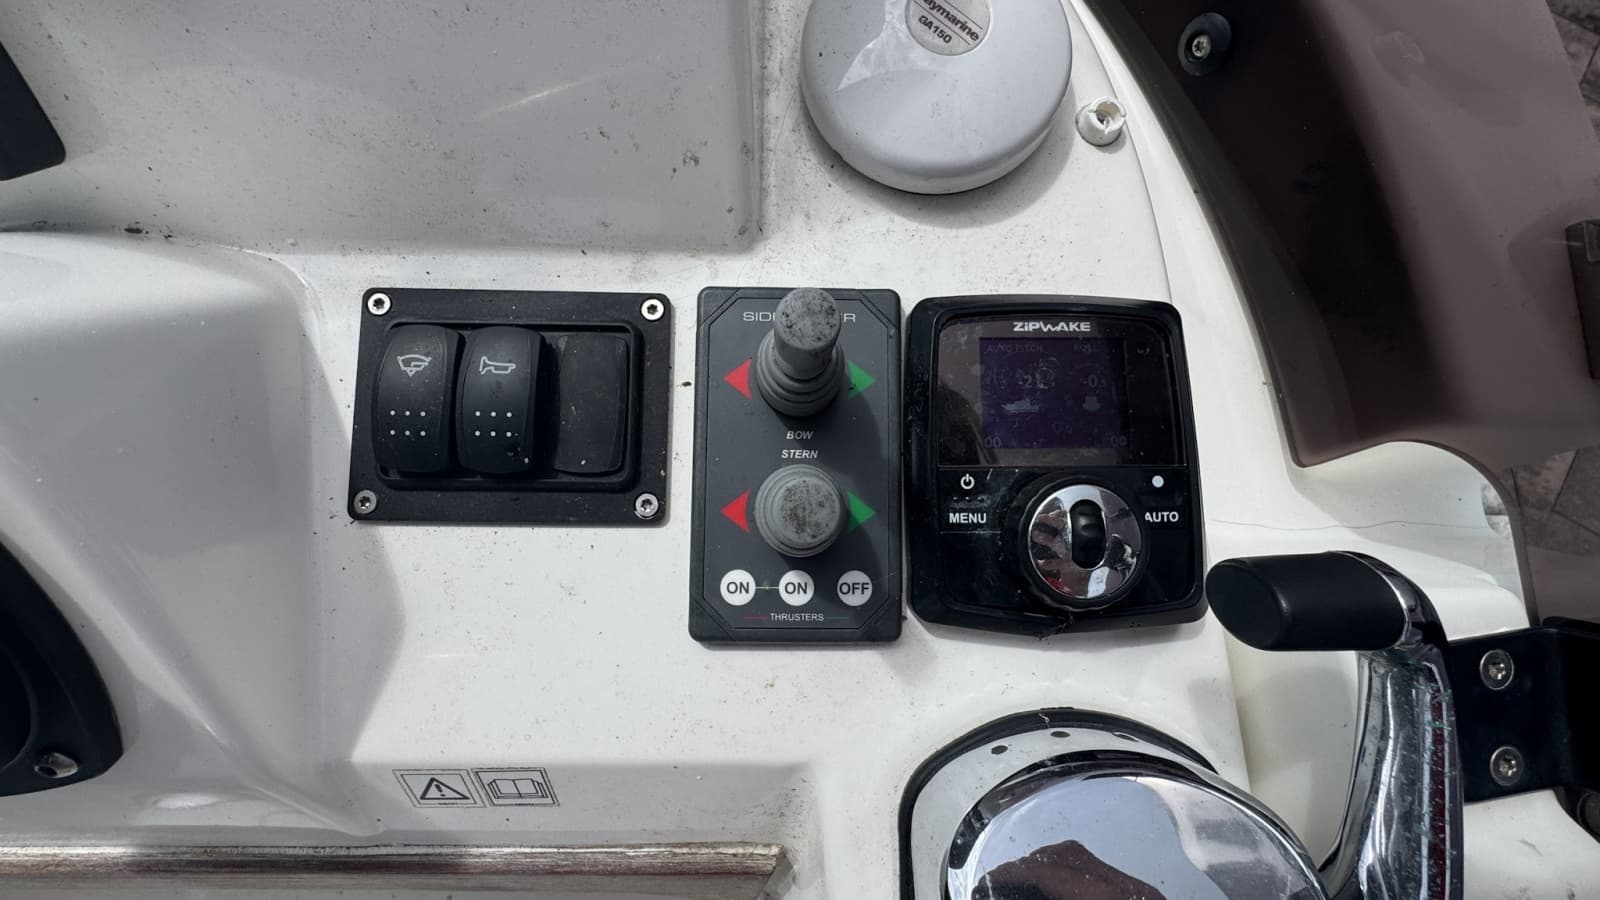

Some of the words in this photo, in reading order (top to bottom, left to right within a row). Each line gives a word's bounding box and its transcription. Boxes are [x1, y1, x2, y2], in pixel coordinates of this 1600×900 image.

[923, 0, 980, 41] aymarine
[918, 15, 952, 44] GA150
[786, 430, 813, 440] BOW
[781, 449, 818, 459] STERN
[949, 512, 987, 524] MENU
[1144, 511, 1179, 523] AUTO
[726, 581, 750, 594] ON
[784, 582, 808, 595] ON
[839, 582, 870, 595] OFF
[770, 611, 824, 622] THRUSTERS
